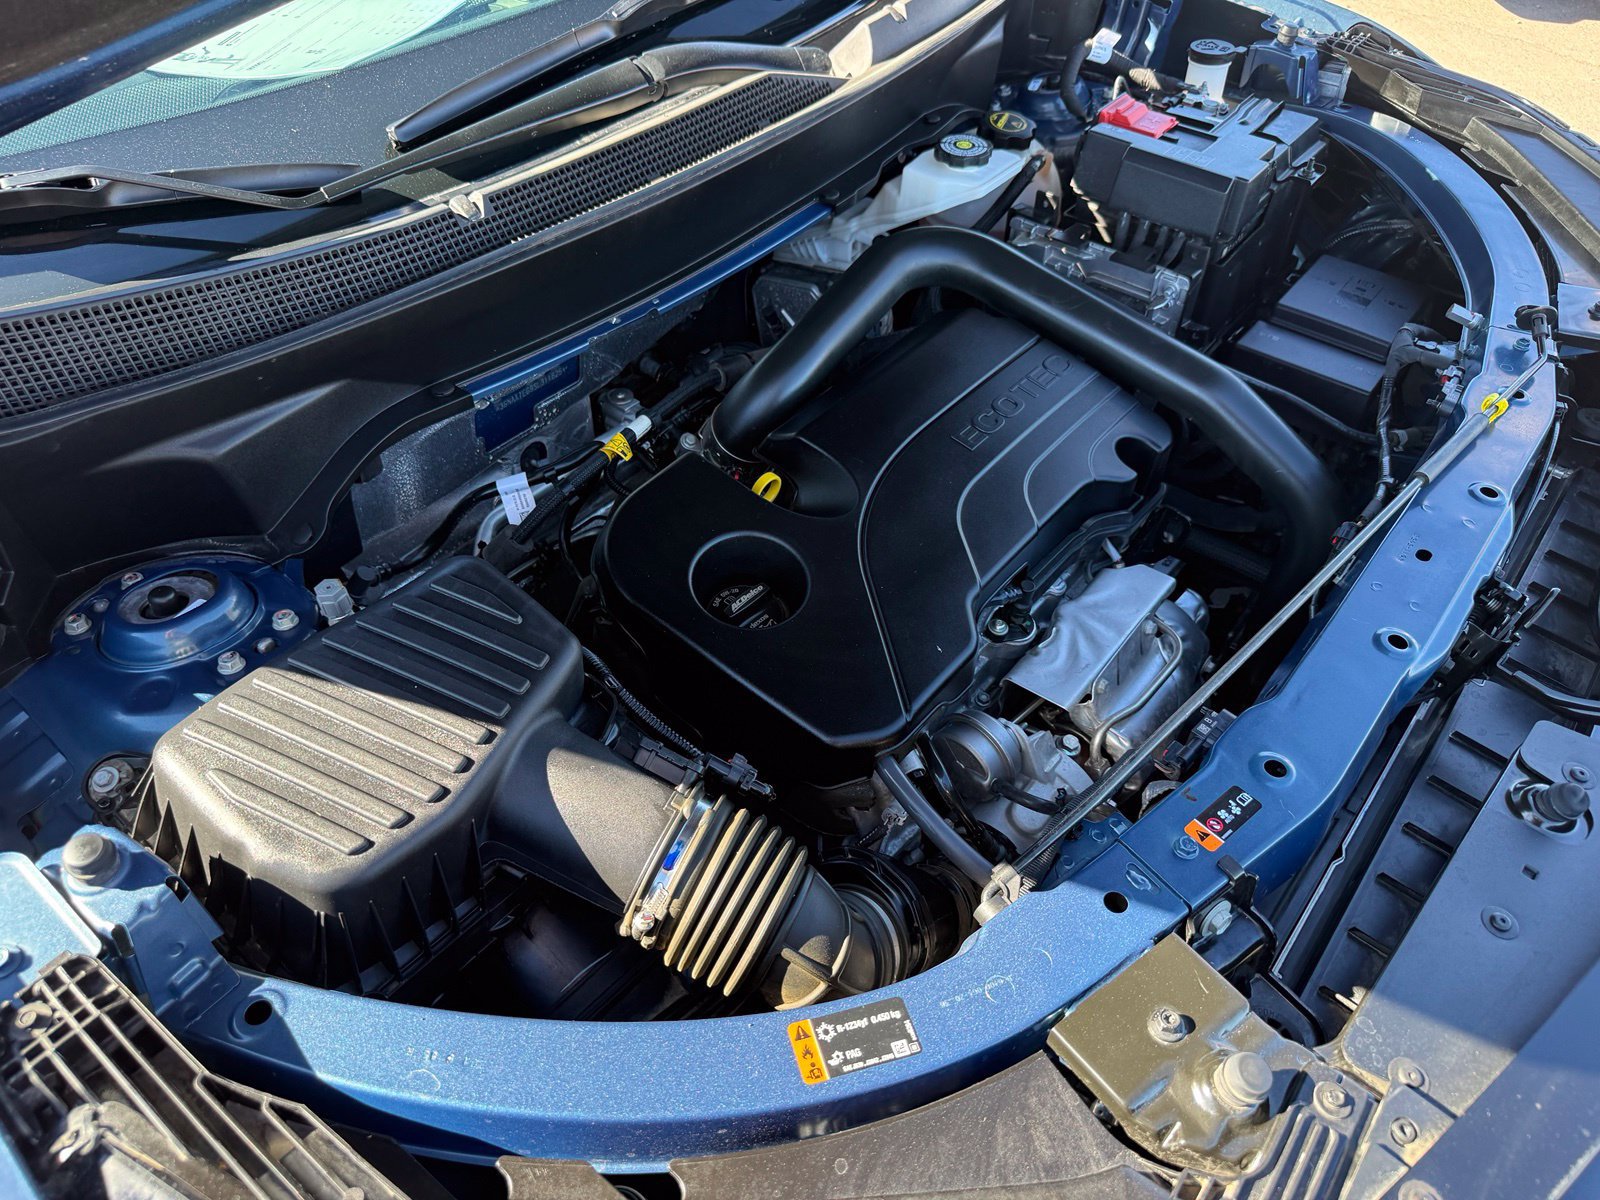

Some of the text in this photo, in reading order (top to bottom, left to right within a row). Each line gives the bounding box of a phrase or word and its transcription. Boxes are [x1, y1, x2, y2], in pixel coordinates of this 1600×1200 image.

[951, 355, 1071, 451] ECOTEC
[731, 585, 764, 613] ACDelco
[889, 1009, 902, 1019] kg
[845, 1048, 862, 1060] PAG
